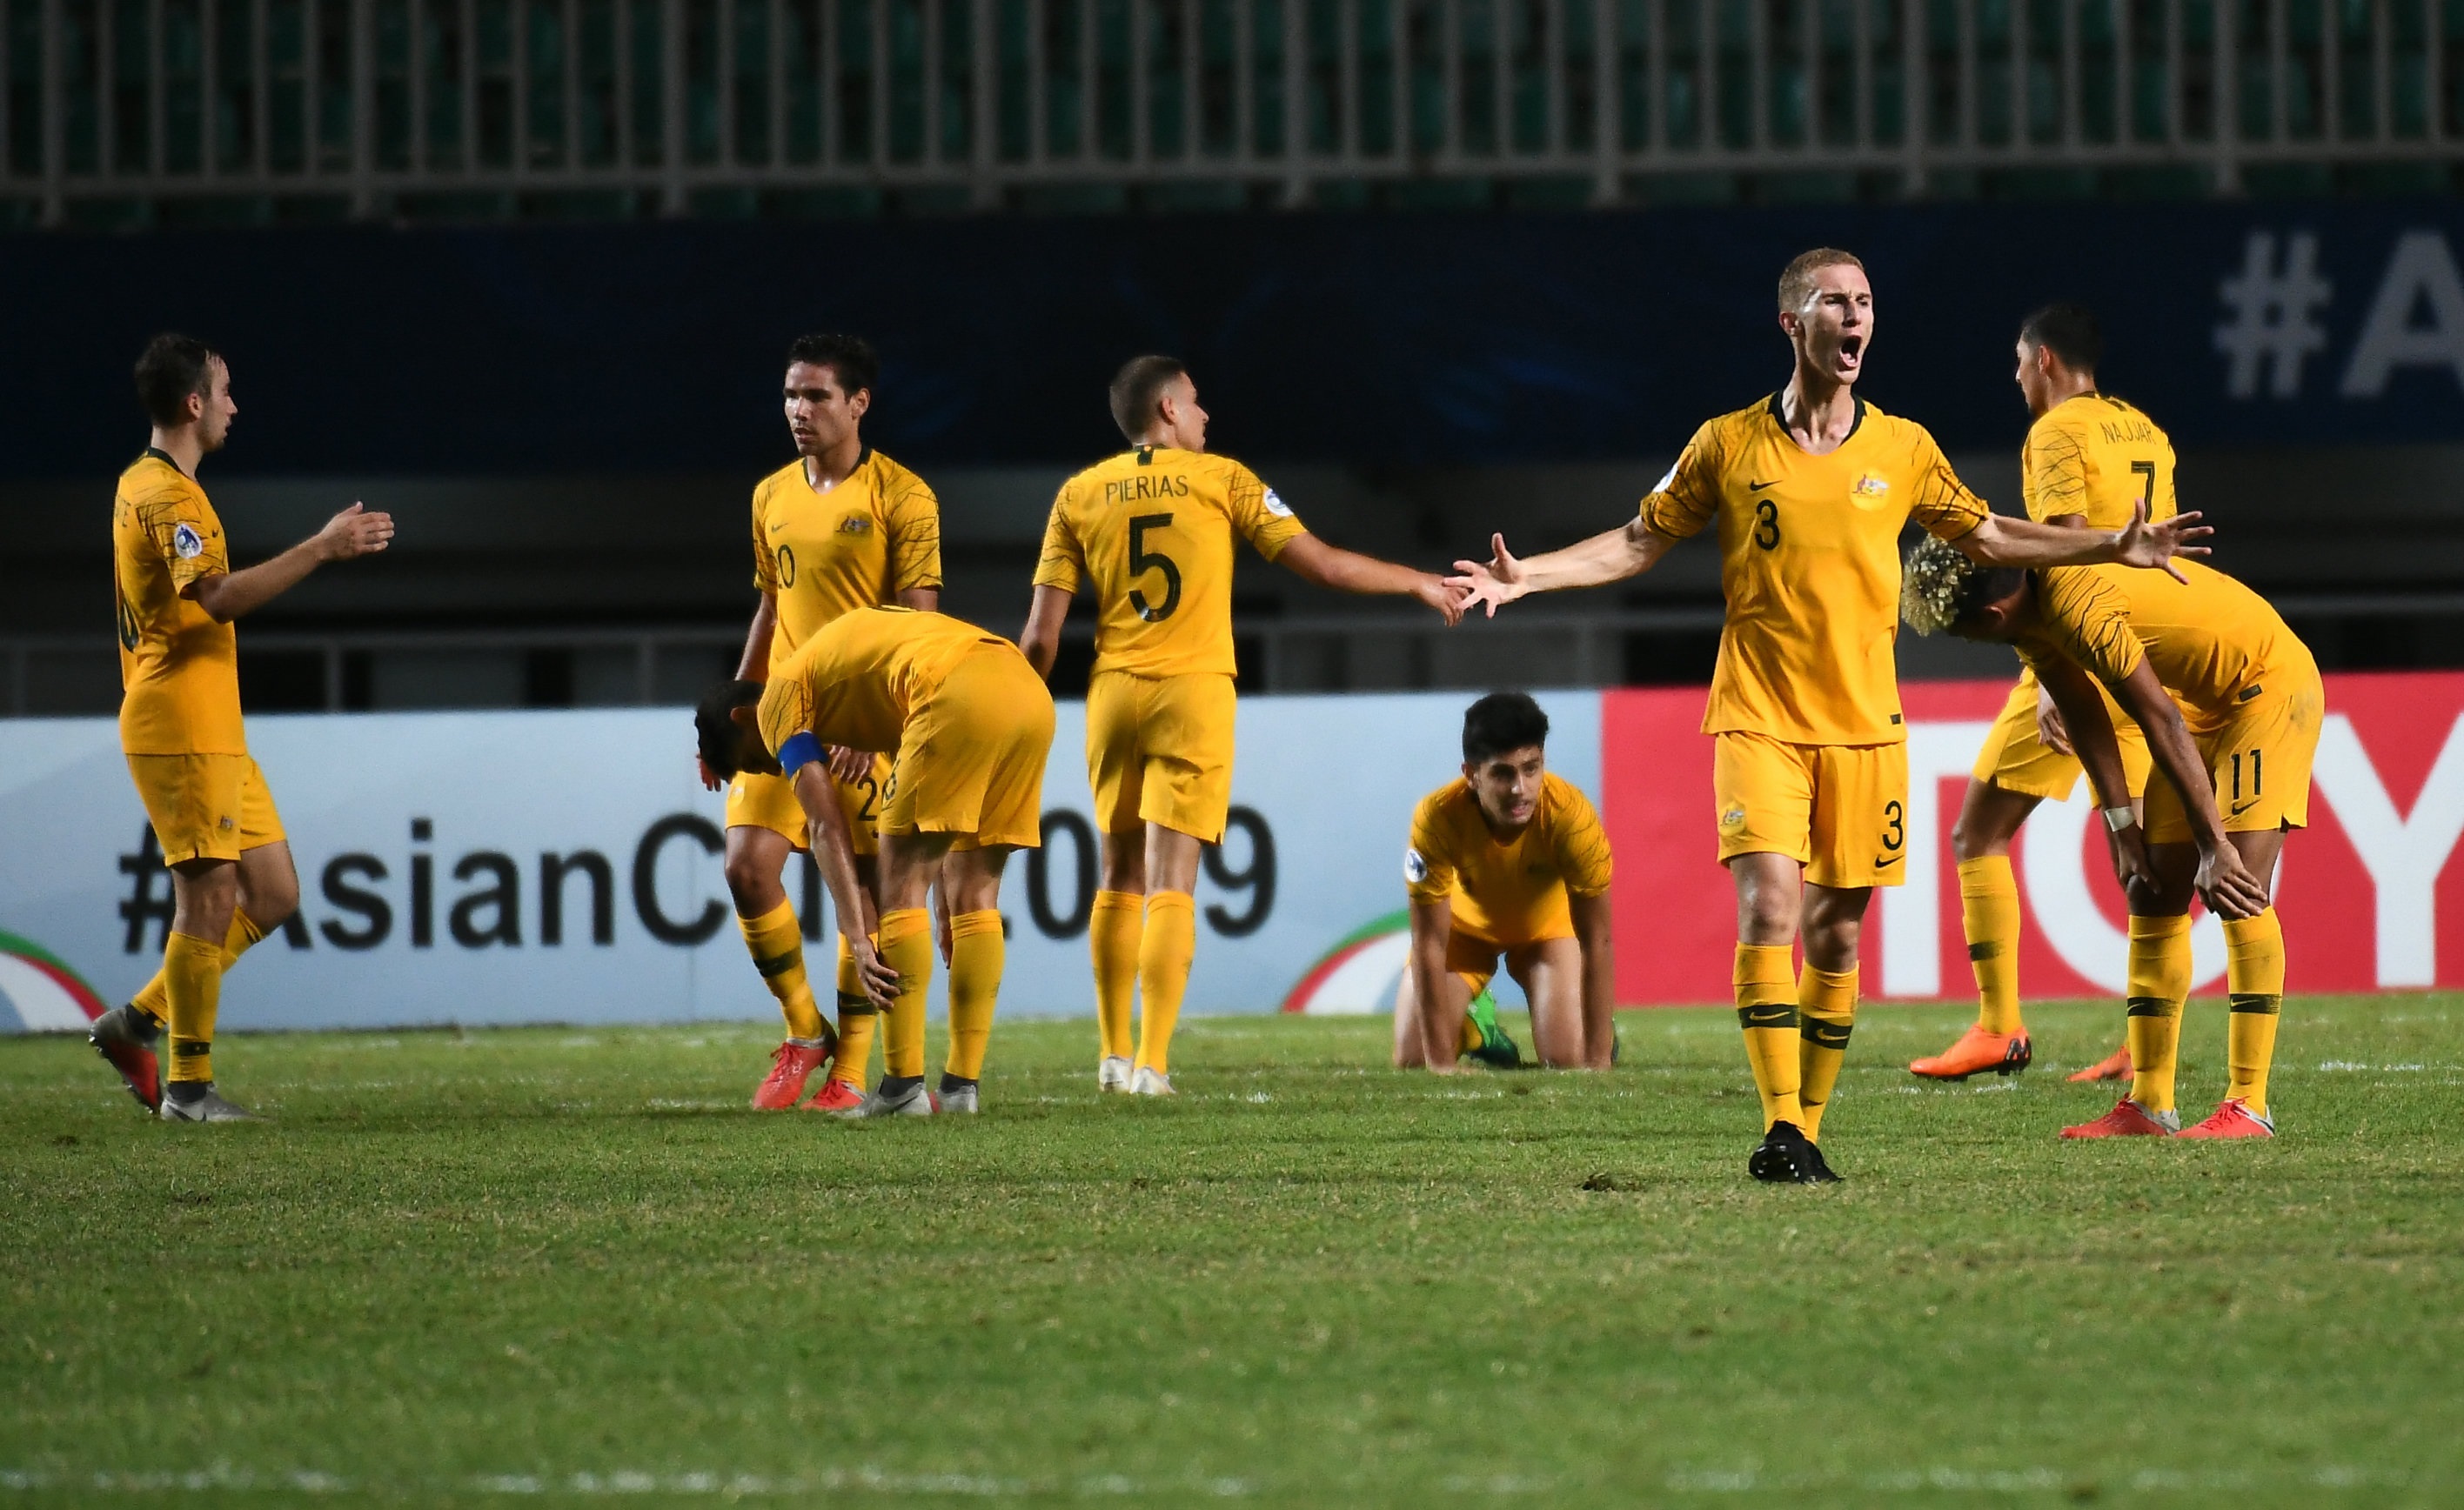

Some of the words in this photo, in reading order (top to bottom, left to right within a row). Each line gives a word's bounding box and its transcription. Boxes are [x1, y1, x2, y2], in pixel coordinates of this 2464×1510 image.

[2099, 420, 2157, 444] NAJJAR
[1105, 475, 1188, 505] PIERIAS
[2131, 460, 2155, 524] 7
[1755, 499, 1780, 551] 3
[778, 544, 795, 590] 0
[1128, 512, 1182, 623] 5
[857, 777, 888, 822] 2
[2231, 749, 2261, 800] 11
[1882, 800, 1904, 851] 3
